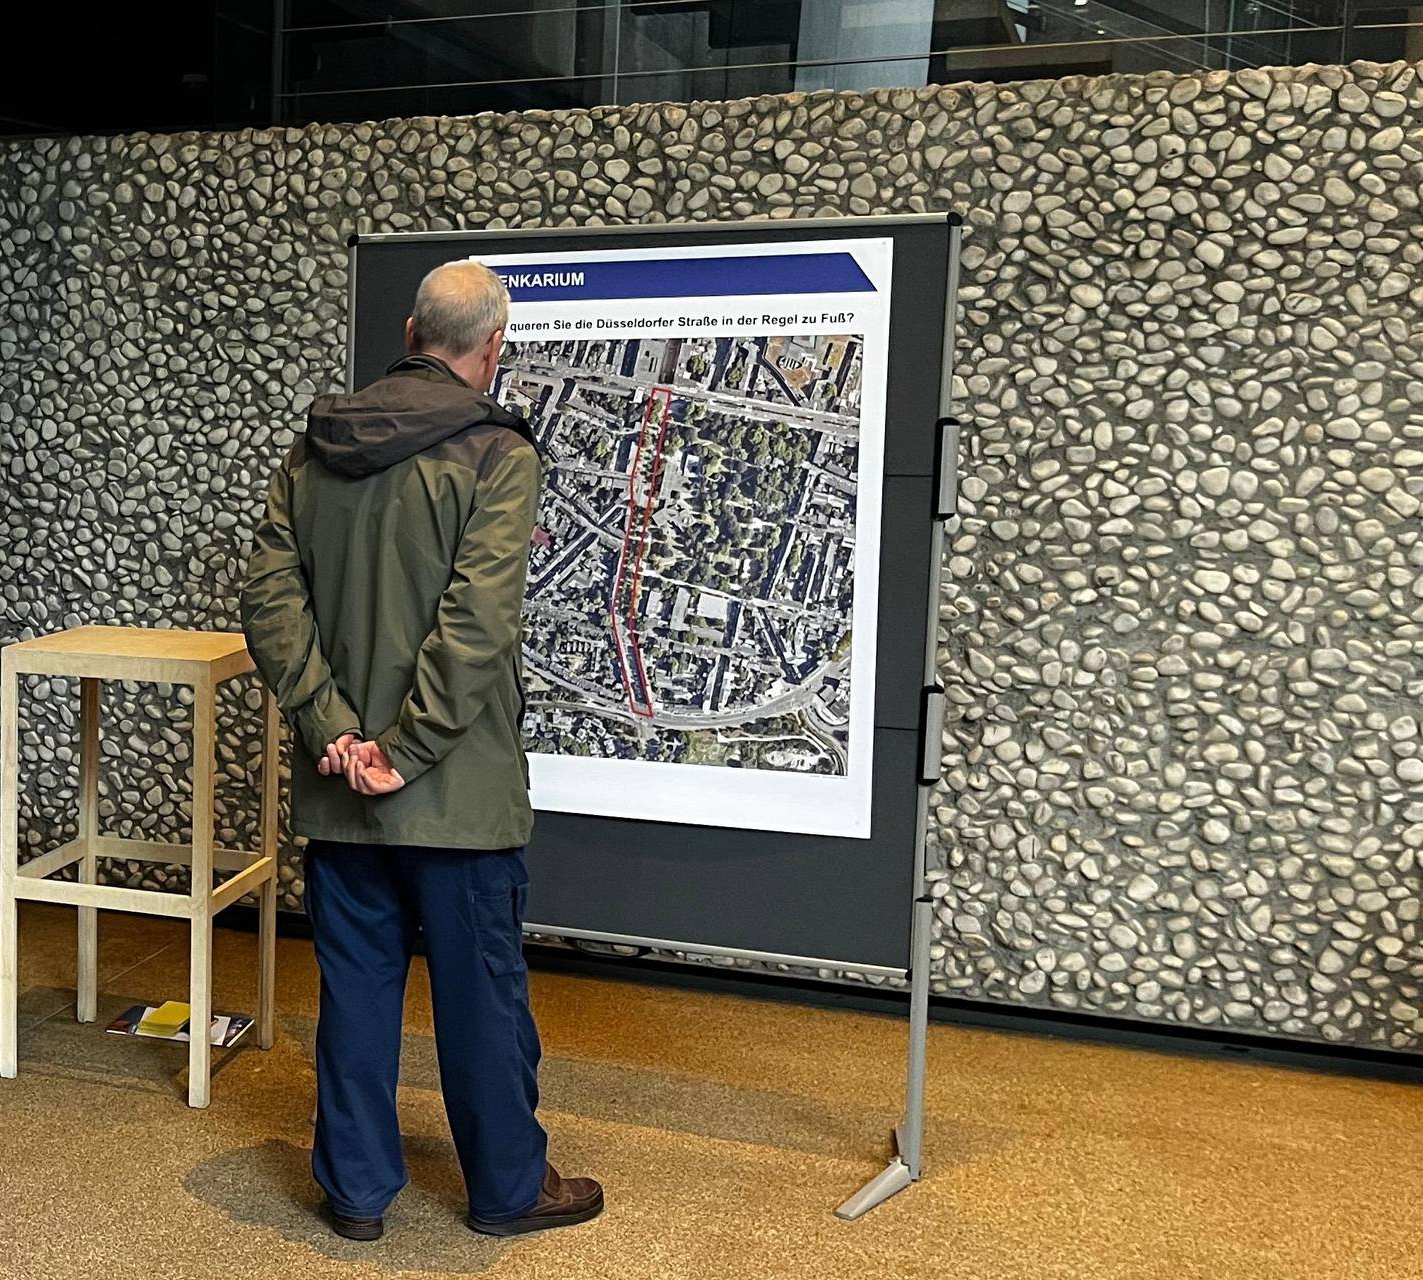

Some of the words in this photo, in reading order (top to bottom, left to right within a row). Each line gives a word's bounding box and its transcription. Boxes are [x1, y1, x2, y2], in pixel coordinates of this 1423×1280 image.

[497, 271, 585, 288] ENKARIUM
[509, 318, 550, 332] queren
[553, 318, 571, 330] Sie
[575, 317, 593, 330] die
[596, 316, 675, 329] Düsseldorfer
[678, 315, 718, 327] Straße
[721, 315, 734, 327] in
[737, 314, 758, 326] der
[761, 313, 798, 328] Regel
[801, 315, 817, 324] zu
[820, 312, 855, 324] Fuß?
